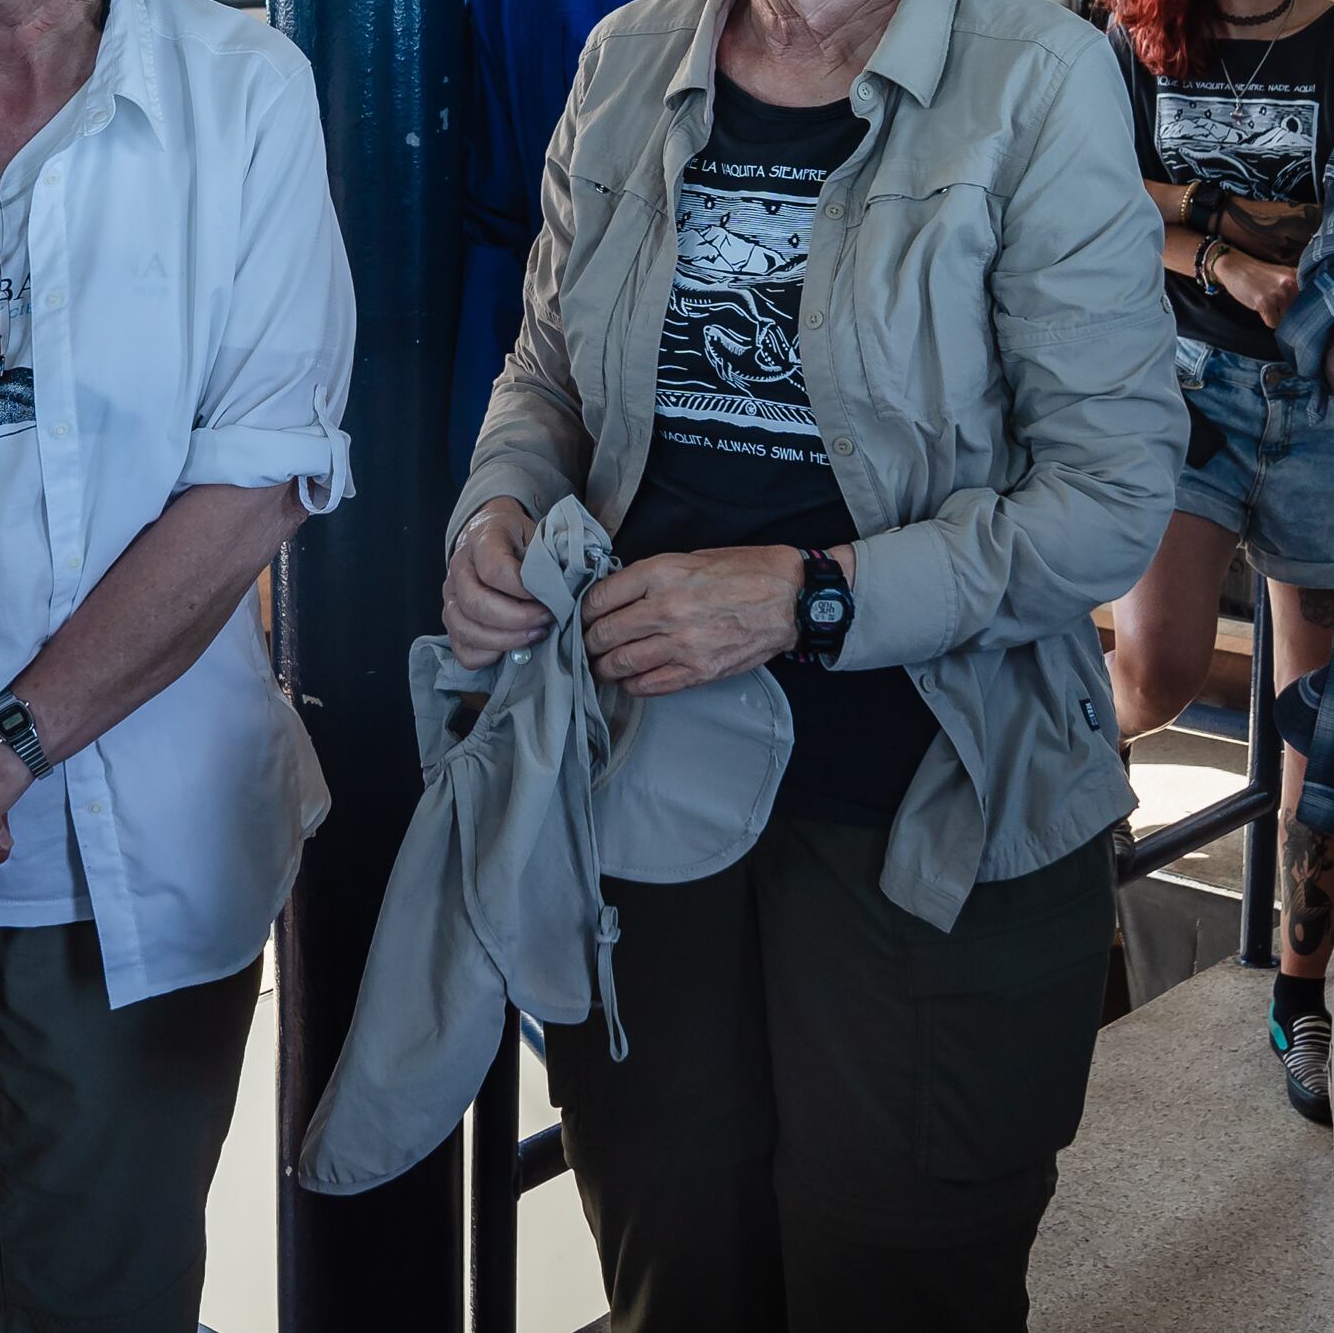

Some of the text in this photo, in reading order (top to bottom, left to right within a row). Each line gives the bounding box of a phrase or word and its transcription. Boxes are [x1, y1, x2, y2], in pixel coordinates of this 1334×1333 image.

[1195, 81, 1232, 91] VAQUITA
[1268, 84, 1291, 93] NADE
[701, 159, 828, 183] LA VAQUITA SIEMPRE
[717, 439, 767, 457] ALWAYS
[770, 446, 804, 462] SWIM
